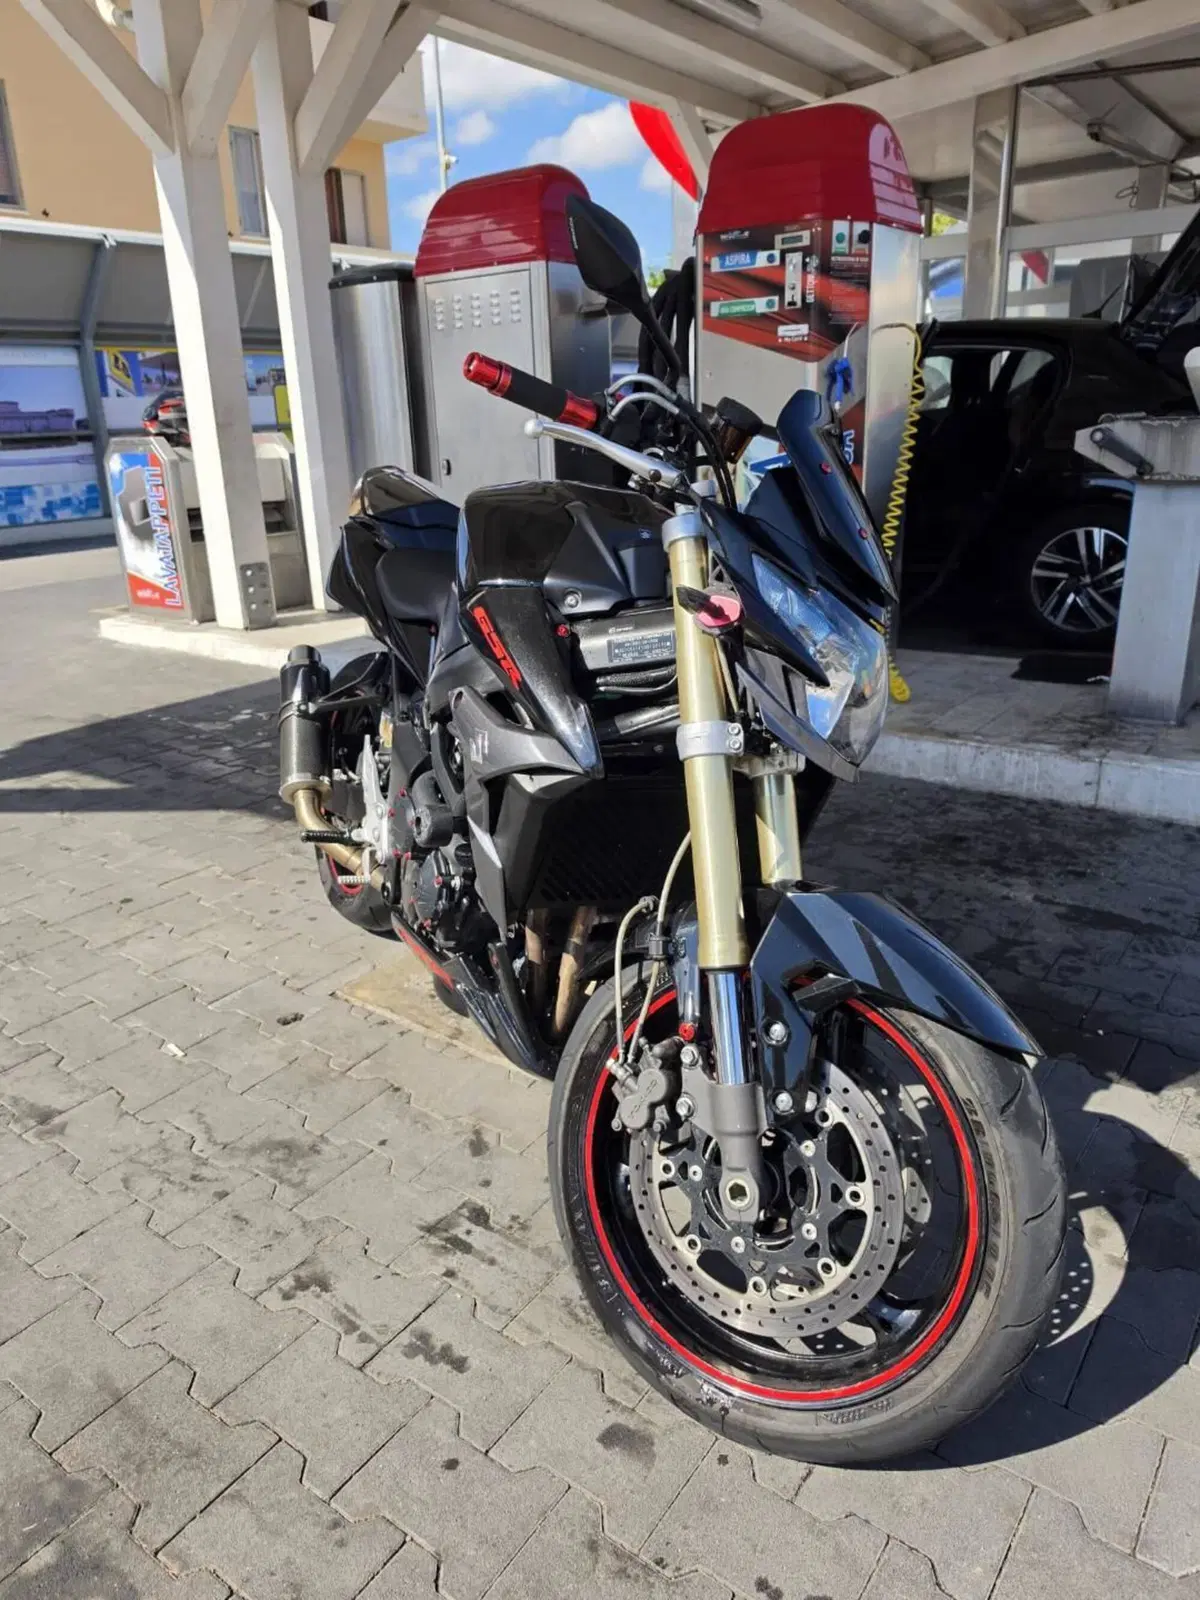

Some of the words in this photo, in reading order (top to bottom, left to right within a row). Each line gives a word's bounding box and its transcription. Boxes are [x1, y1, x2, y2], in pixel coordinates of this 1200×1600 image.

[724, 251, 752, 267] ASPIRA
[145, 466, 182, 606] LAVATAPPETI
[473, 606, 522, 691] GSR
